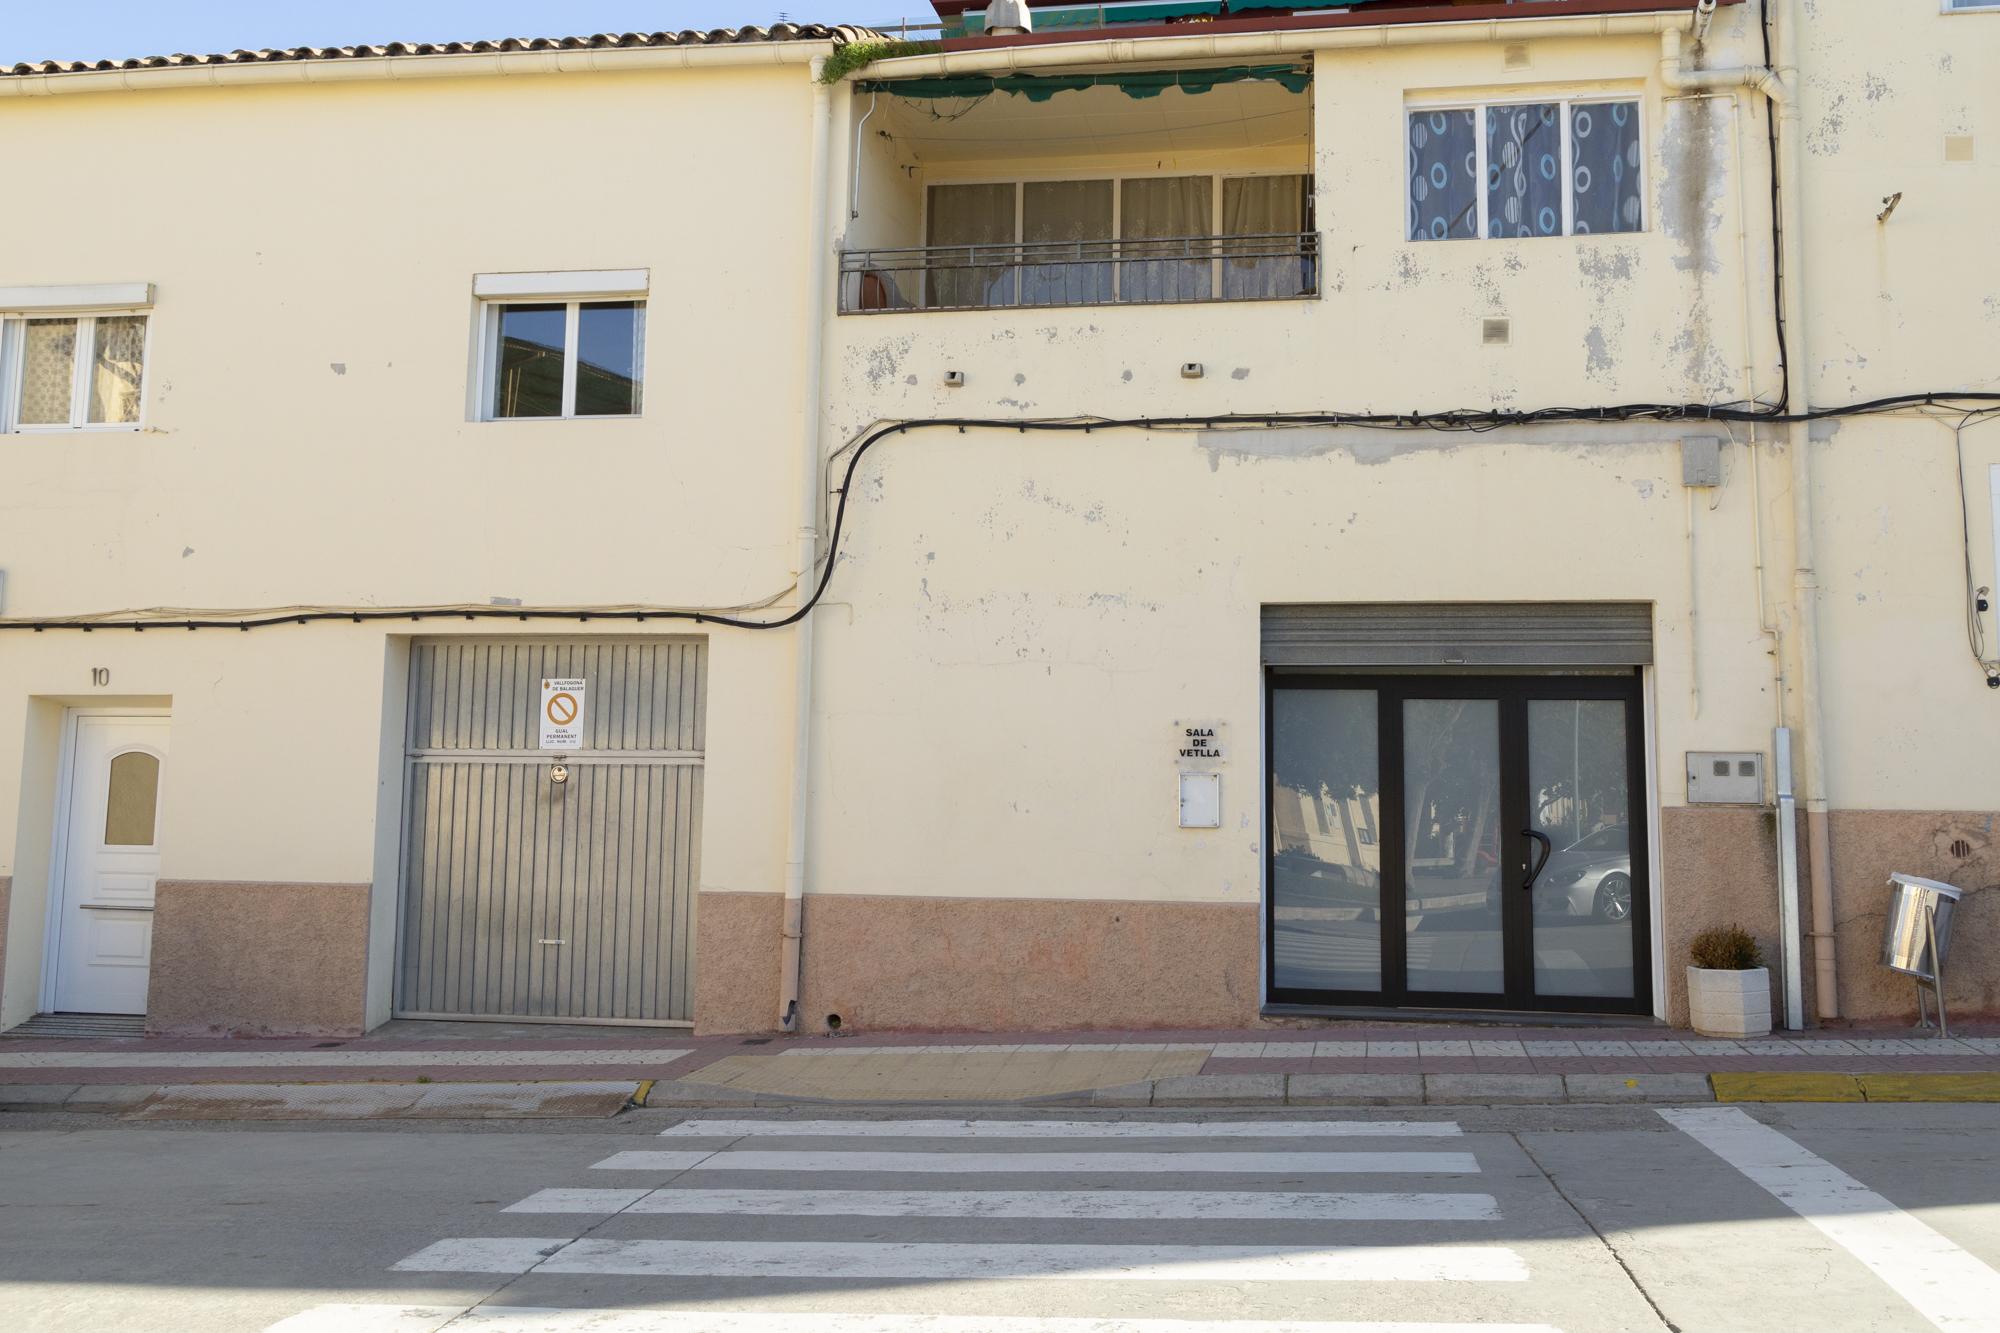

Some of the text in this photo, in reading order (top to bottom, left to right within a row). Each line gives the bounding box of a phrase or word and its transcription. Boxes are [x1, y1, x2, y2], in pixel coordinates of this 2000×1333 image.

[91, 667, 110, 695] 10
[1185, 729, 1214, 737] SALA
[1192, 739, 1207, 747] DE
[1179, 749, 1220, 757] VETLLA
